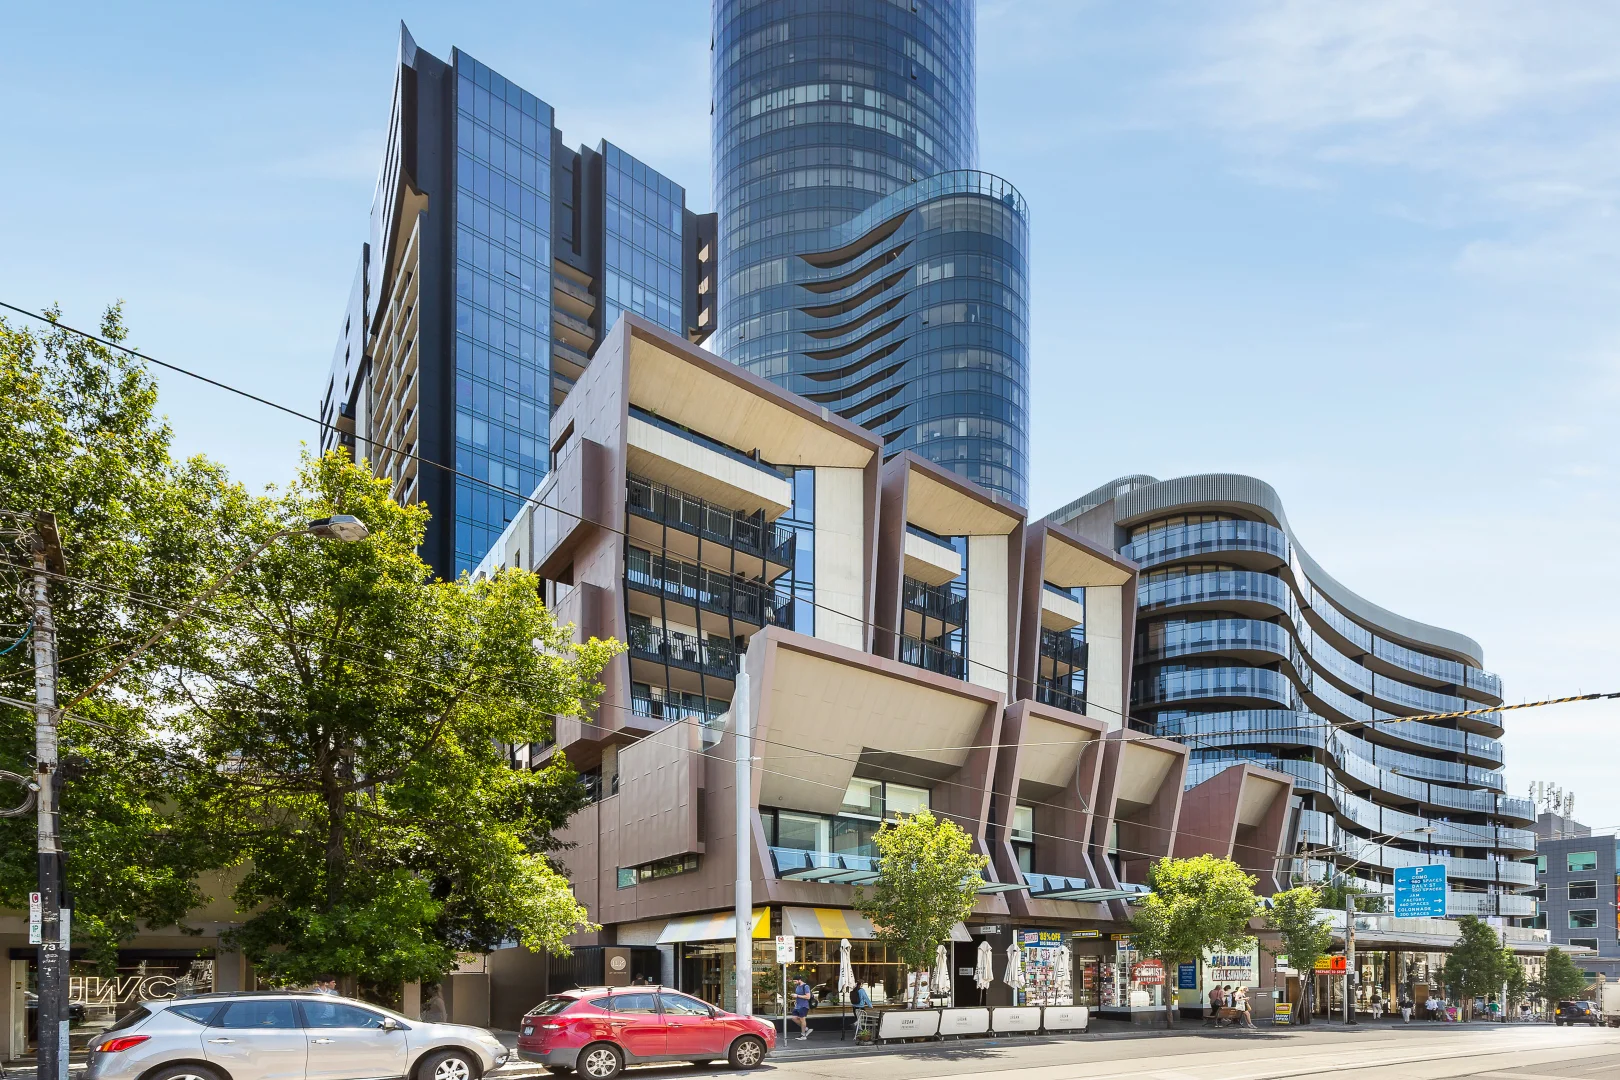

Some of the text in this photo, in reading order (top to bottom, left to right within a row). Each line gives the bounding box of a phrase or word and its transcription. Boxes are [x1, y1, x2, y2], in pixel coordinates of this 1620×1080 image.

[1051, 932, 1061, 942] OFF
[1212, 955, 1226, 967] REAL
[1136, 967, 1163, 977] CHEMIST
[1213, 969, 1227, 981] REAL
